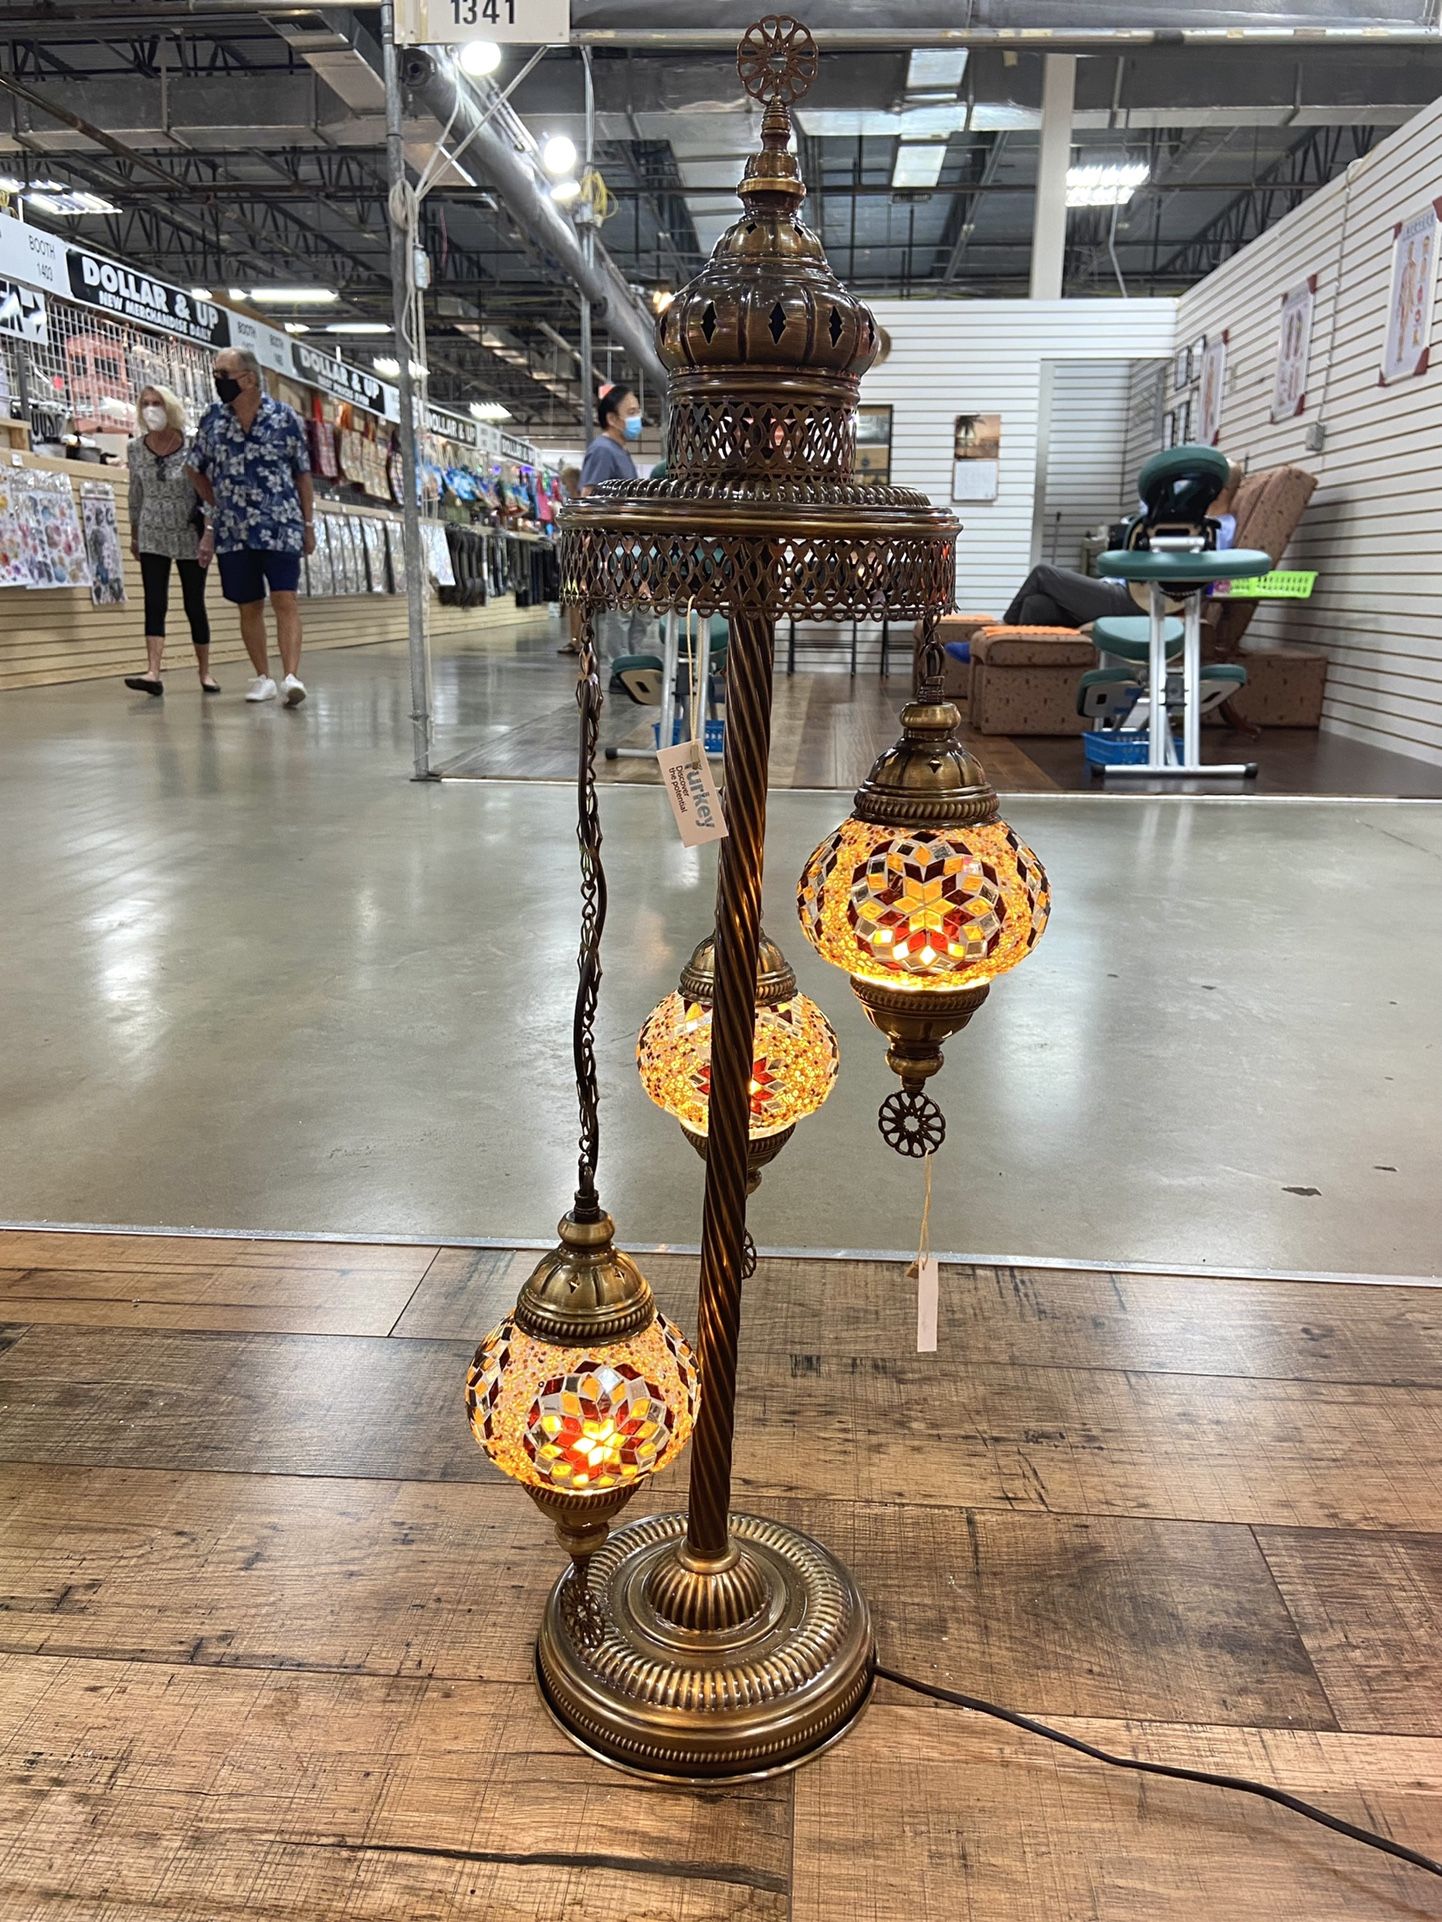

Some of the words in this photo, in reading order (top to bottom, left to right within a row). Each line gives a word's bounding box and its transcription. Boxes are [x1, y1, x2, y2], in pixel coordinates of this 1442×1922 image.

[450, 0, 515, 25] 1341
[28, 235, 56, 259] BOOTH
[81, 256, 169, 313] DOLLAR
[174, 293, 191, 321] &
[195, 301, 219, 329] UP
[98, 290, 123, 311] NEW
[125, 300, 188, 333] MERCHANDISE
[299, 346, 349, 387] DOLLAR
[351, 371, 362, 393] &
[363, 378, 380, 400] UP
[668, 767, 677, 781] the
[675, 765, 690, 797] Discover
[671, 781, 688, 813] potential
